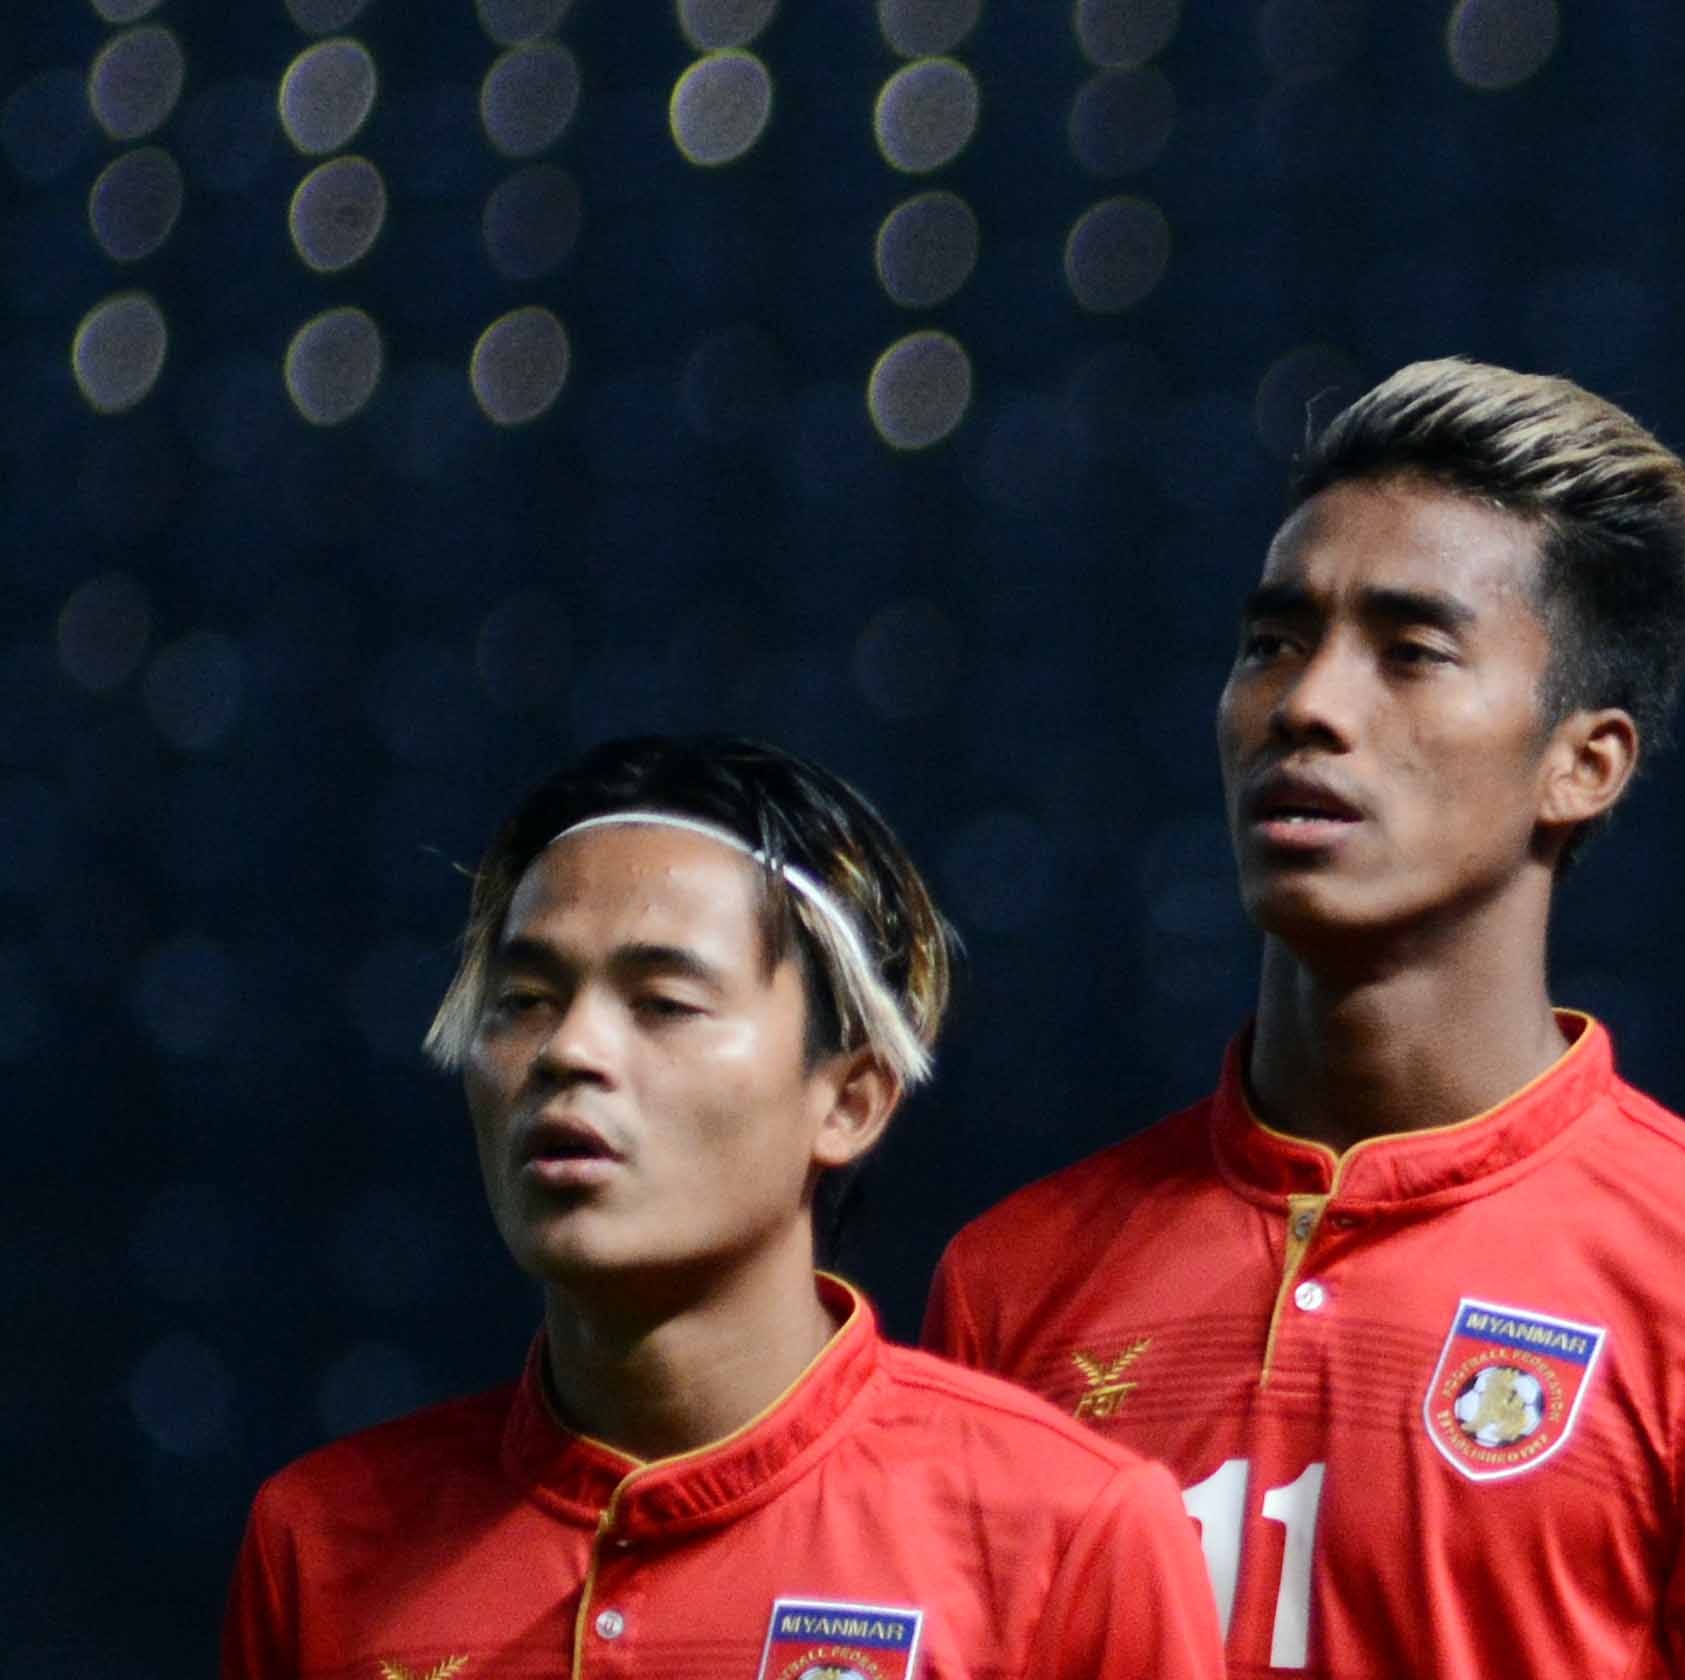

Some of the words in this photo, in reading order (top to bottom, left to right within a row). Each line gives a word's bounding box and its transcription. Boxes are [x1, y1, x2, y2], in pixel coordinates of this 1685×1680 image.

[1466, 1312, 1587, 1354] MYANMAR
[1181, 1459, 1326, 1668] 11
[781, 1616, 905, 1640] MYANMAR
